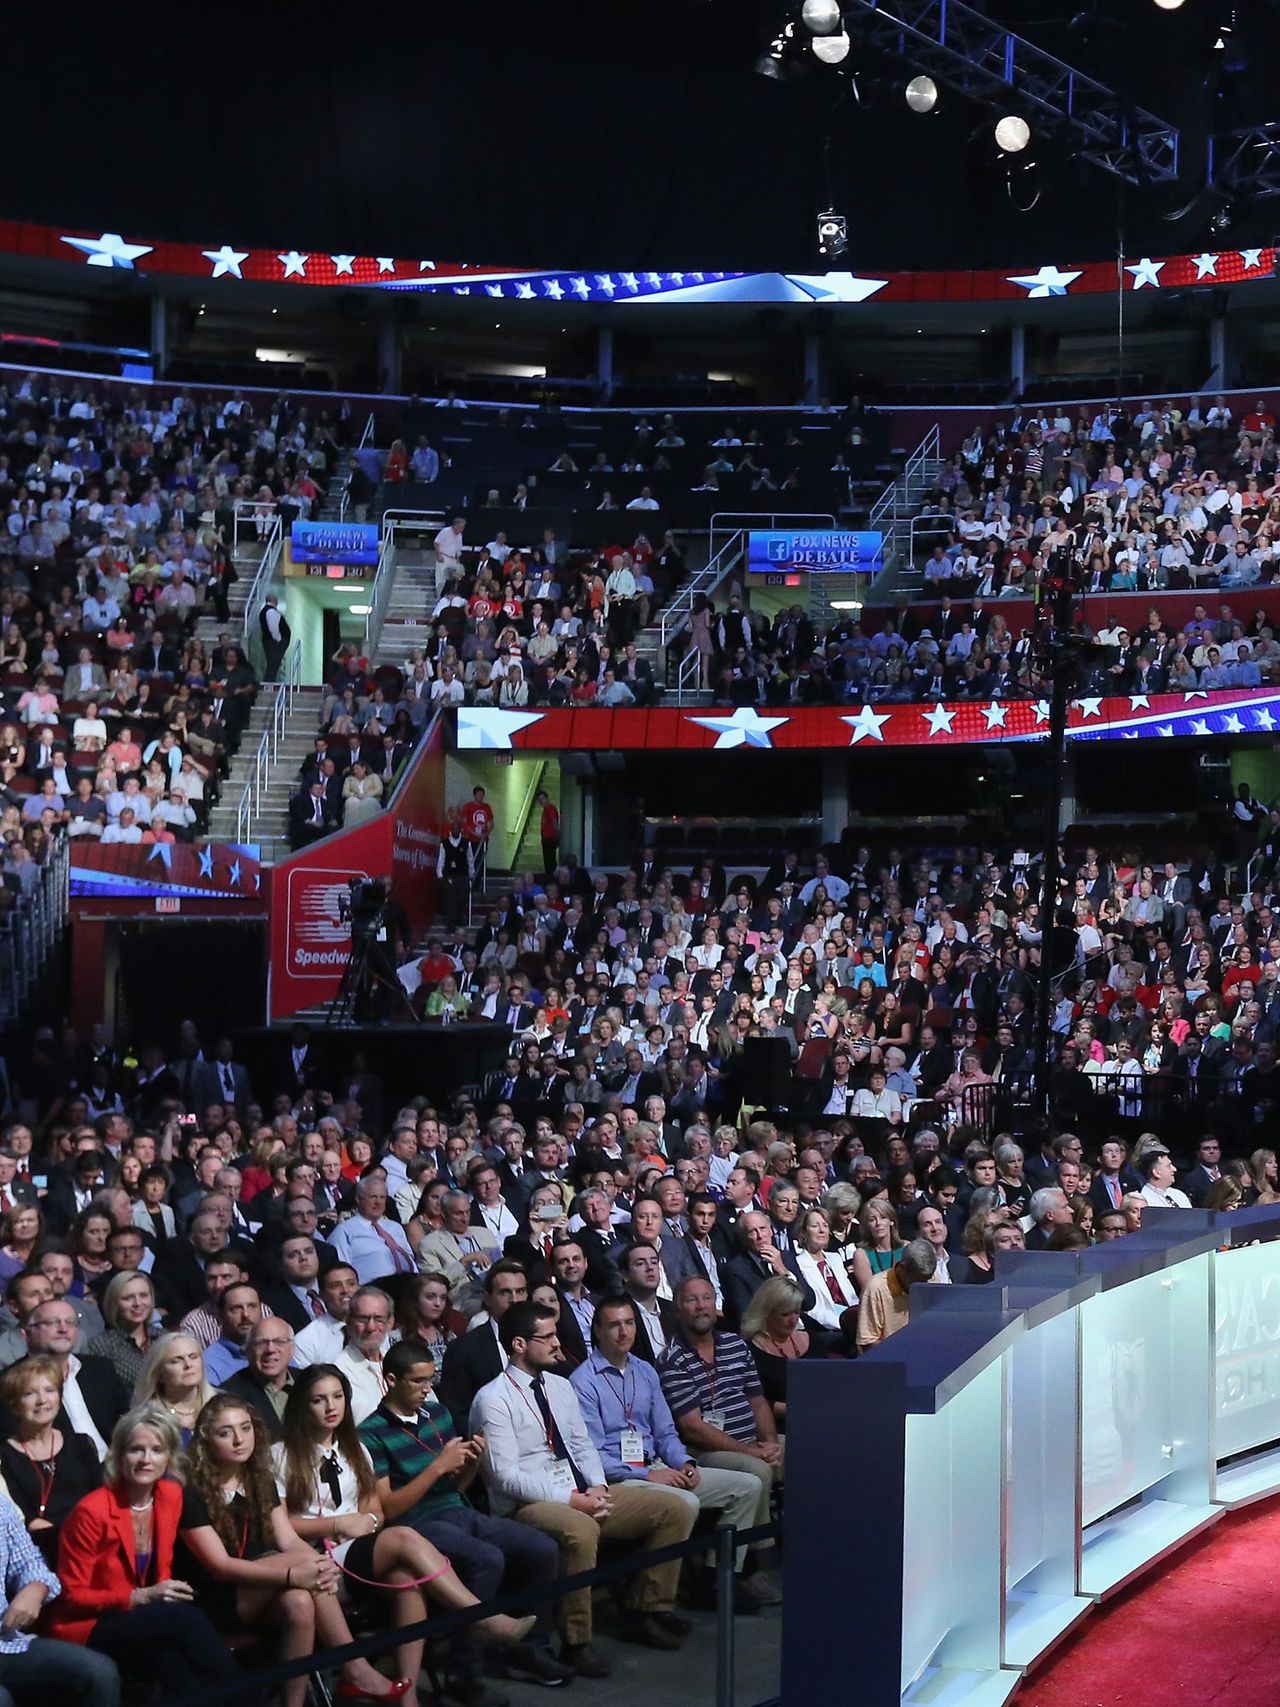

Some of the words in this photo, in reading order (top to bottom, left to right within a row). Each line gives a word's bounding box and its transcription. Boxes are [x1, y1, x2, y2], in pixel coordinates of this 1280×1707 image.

[318, 530, 337, 538] FOX
[340, 530, 367, 540] NEWS
[792, 535, 818, 548] FOX
[821, 535, 860, 548] NEWS
[319, 540, 365, 550] DEBATE
[792, 550, 860, 563] DEBATE
[295, 948, 357, 966] Speedw
